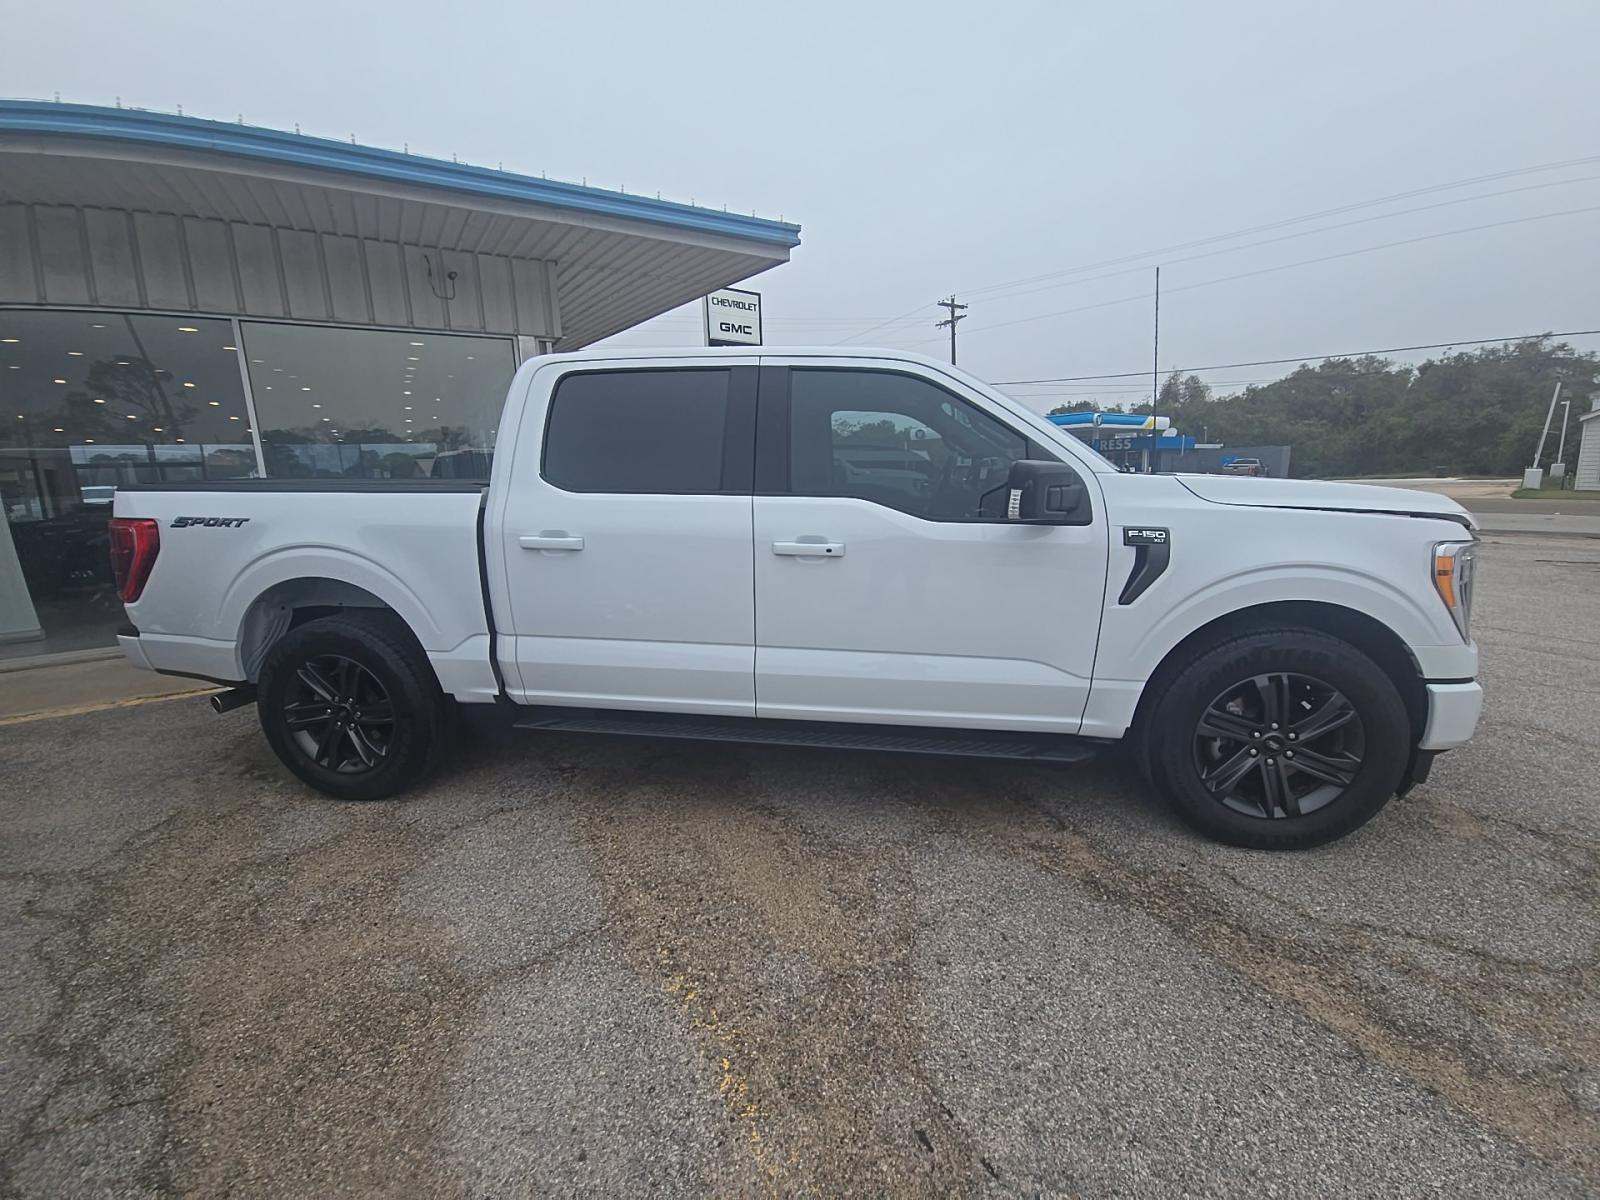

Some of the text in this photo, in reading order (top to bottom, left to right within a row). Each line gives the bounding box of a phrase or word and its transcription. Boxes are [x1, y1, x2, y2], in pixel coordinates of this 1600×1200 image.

[711, 297, 758, 312] CHEVROLET
[719, 322, 753, 335] GMC
[1096, 439, 1132, 451] RESS
[169, 516, 251, 529] SPORT
[1127, 530, 1166, 538] F-150
